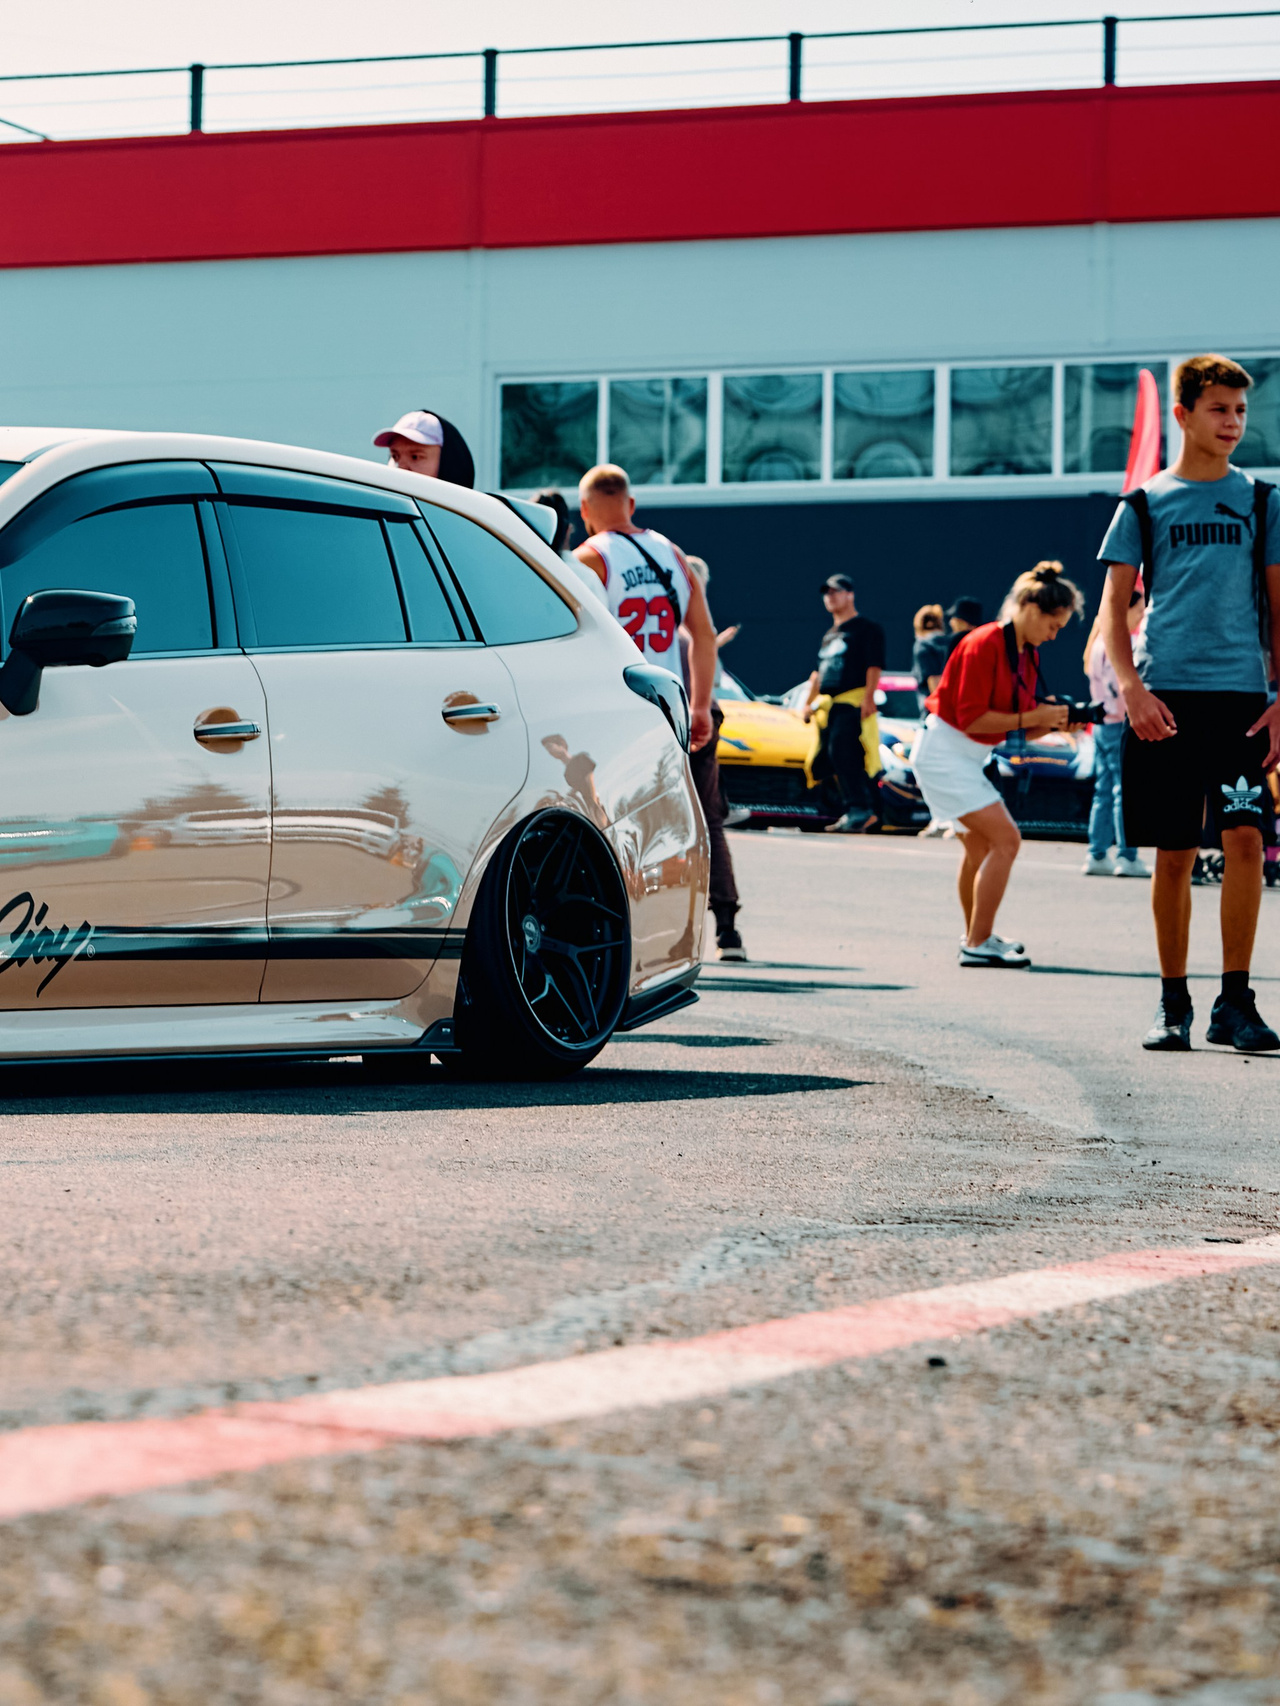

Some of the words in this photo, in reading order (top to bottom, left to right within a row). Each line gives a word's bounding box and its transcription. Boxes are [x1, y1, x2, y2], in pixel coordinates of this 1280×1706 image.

[1169, 522, 1242, 548] PUMA
[621, 564, 673, 591] JORD
[618, 595, 676, 653] 23
